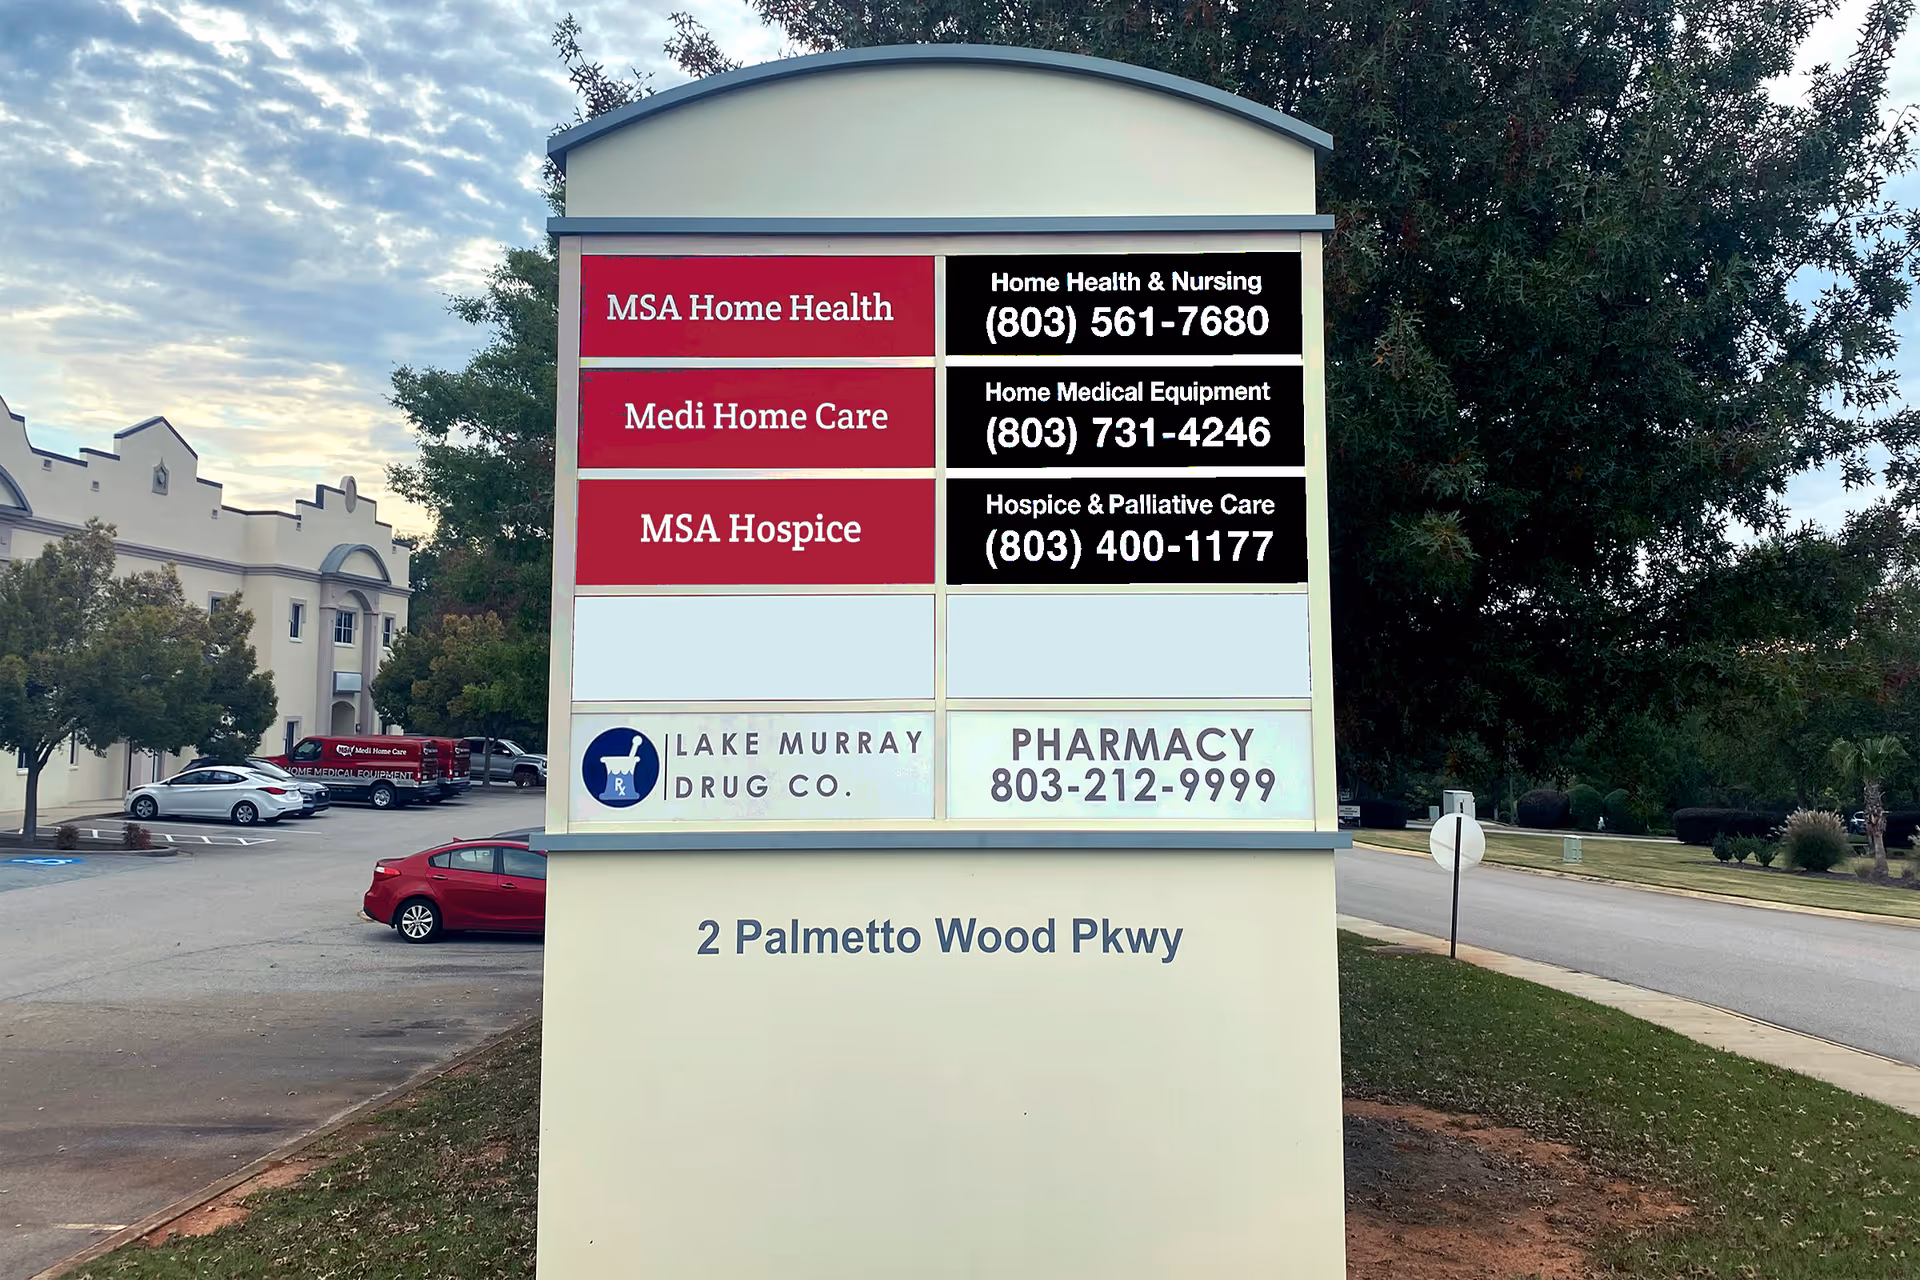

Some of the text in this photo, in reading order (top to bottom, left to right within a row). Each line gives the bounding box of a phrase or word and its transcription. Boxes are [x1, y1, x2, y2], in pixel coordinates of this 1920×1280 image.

[991, 270, 1263, 295] Home Health & Nursing
[606, 292, 895, 322] MSA Home Health
[985, 305, 1270, 345] (803) 561-7680
[985, 381, 1271, 406] Home Medical Equipment
[624, 400, 889, 430] Medi Home Care
[986, 416, 1271, 455] (803) 731-4246
[986, 493, 1275, 519] Hospice & Palliative Care
[640, 513, 862, 552] MSA Hospice
[985, 528, 1274, 570] (803) 400-1177
[373, 747, 391, 755] Home
[392, 748, 407, 756] Care
[676, 730, 923, 757] LAKE MURRAY
[1012, 727, 1255, 762] PHARMACY
[314, 768, 355, 777] MEDICAL
[358, 770, 413, 780] EQUIPMENT
[675, 773, 852, 799] DRUG CO.
[990, 767, 1277, 803] 803-212-9999
[696, 917, 1184, 964] 2 Palmetto Wood Pkwy
